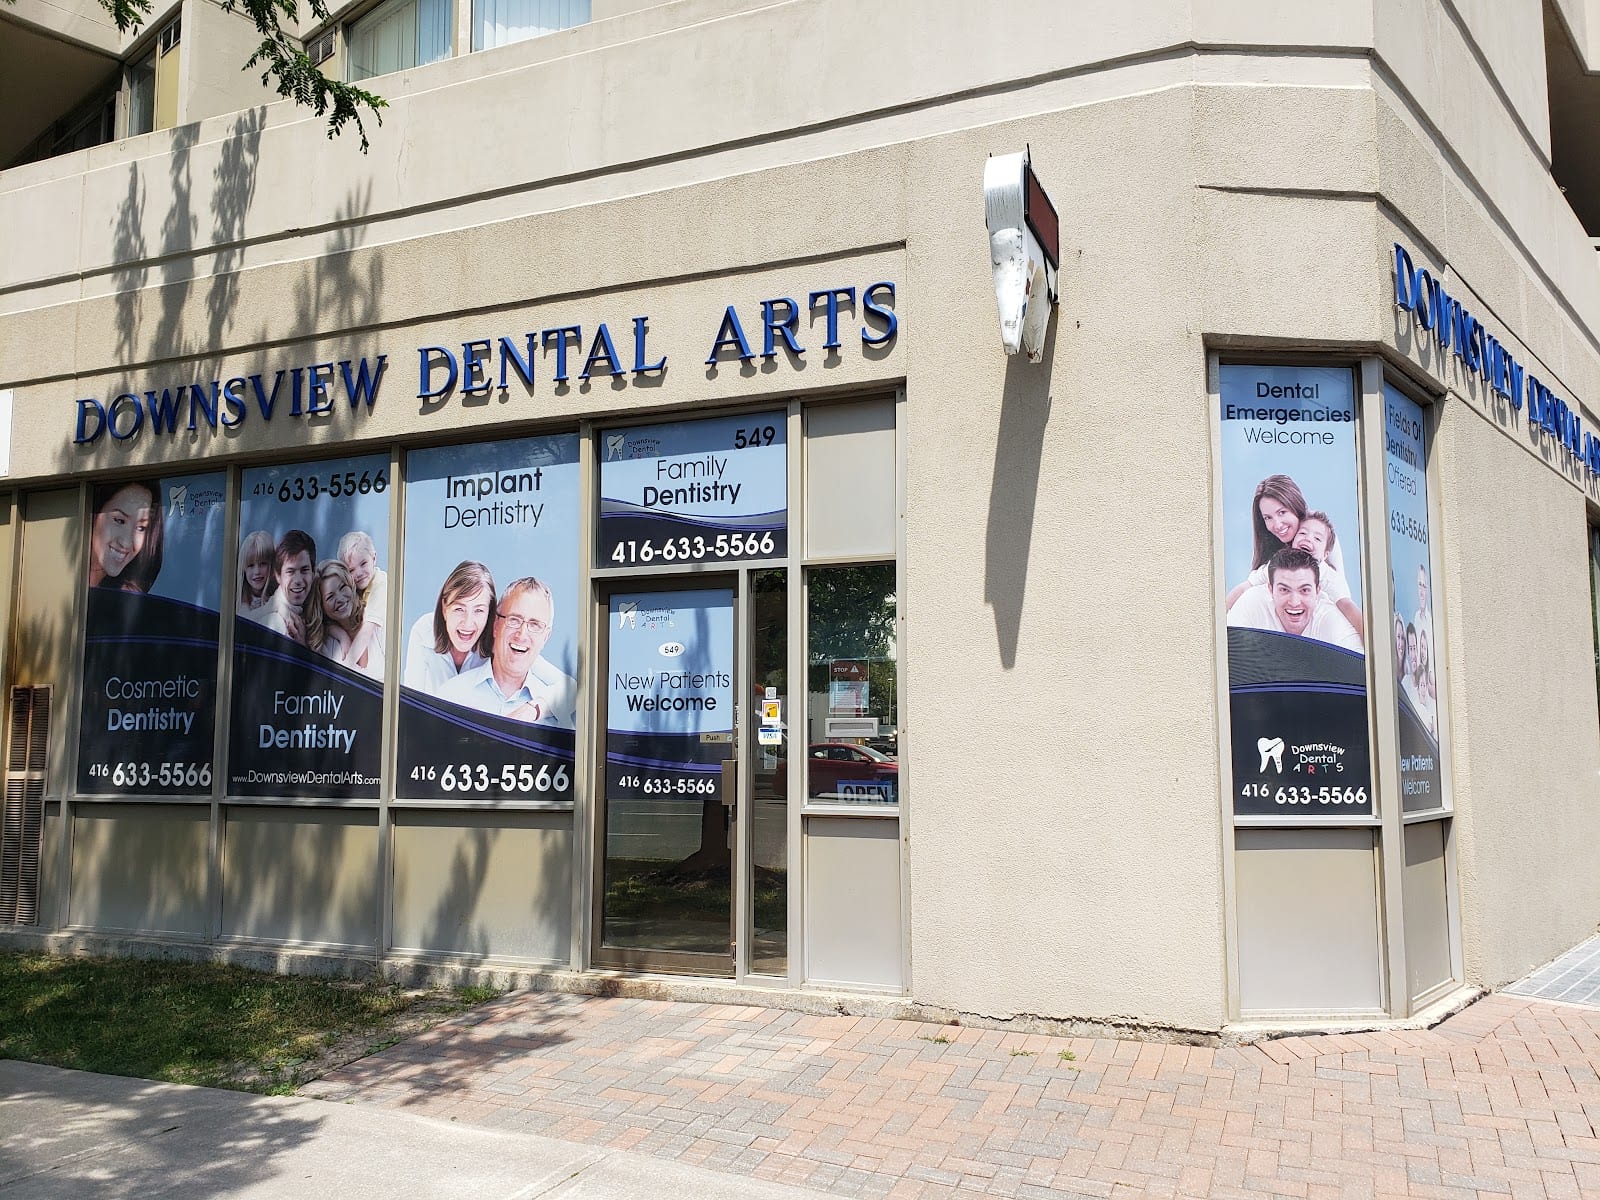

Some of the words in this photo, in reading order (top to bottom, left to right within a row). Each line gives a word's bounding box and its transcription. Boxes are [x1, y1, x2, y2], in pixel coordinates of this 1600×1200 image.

[73, 354, 388, 445] DOWNSVIEW
[416, 315, 667, 400] DENTAL
[704, 281, 898, 366] ARTS
[1256, 382, 1320, 400] Dental
[1226, 404, 1352, 425] Emergencies
[1389, 403, 1410, 436] Fields
[735, 426, 776, 450] 549
[1244, 427, 1335, 445] Welcome
[657, 456, 728, 481] Family
[1388, 462, 1417, 496] Offered
[253, 482, 275, 496] 416
[278, 469, 387, 503] 633-5566
[446, 467, 543, 501] Implant
[643, 481, 741, 507] Dentistry
[444, 500, 544, 529] Dentistry
[1391, 509, 1427, 545] 633-5566
[611, 532, 776, 563] 416-633-5566
[664, 645, 680, 654] 549
[105, 675, 200, 700] Cosmetic
[615, 672, 655, 691] New
[660, 670, 730, 689] Patients
[273, 690, 345, 720] Family
[626, 694, 717, 712] Welcome
[107, 708, 194, 735] Dentistry
[258, 724, 357, 753] Dentistry
[1291, 742, 1346, 756] Downsview
[1299, 753, 1337, 764] Dental
[1400, 755, 1410, 772] ew
[1411, 754, 1433, 771] Patients
[88, 764, 109, 778] 416
[112, 762, 212, 787] 633-5566
[231, 769, 381, 786] www.DownsviewDentalArts.com
[410, 765, 436, 781] 416
[440, 764, 570, 792] 633-5566
[618, 776, 640, 788] 416
[643, 778, 715, 794] 633-5566
[1402, 779, 1430, 795] Welcome
[842, 785, 889, 804] OPEN
[1241, 783, 1270, 798] 416
[1274, 786, 1368, 805] 633-5566
